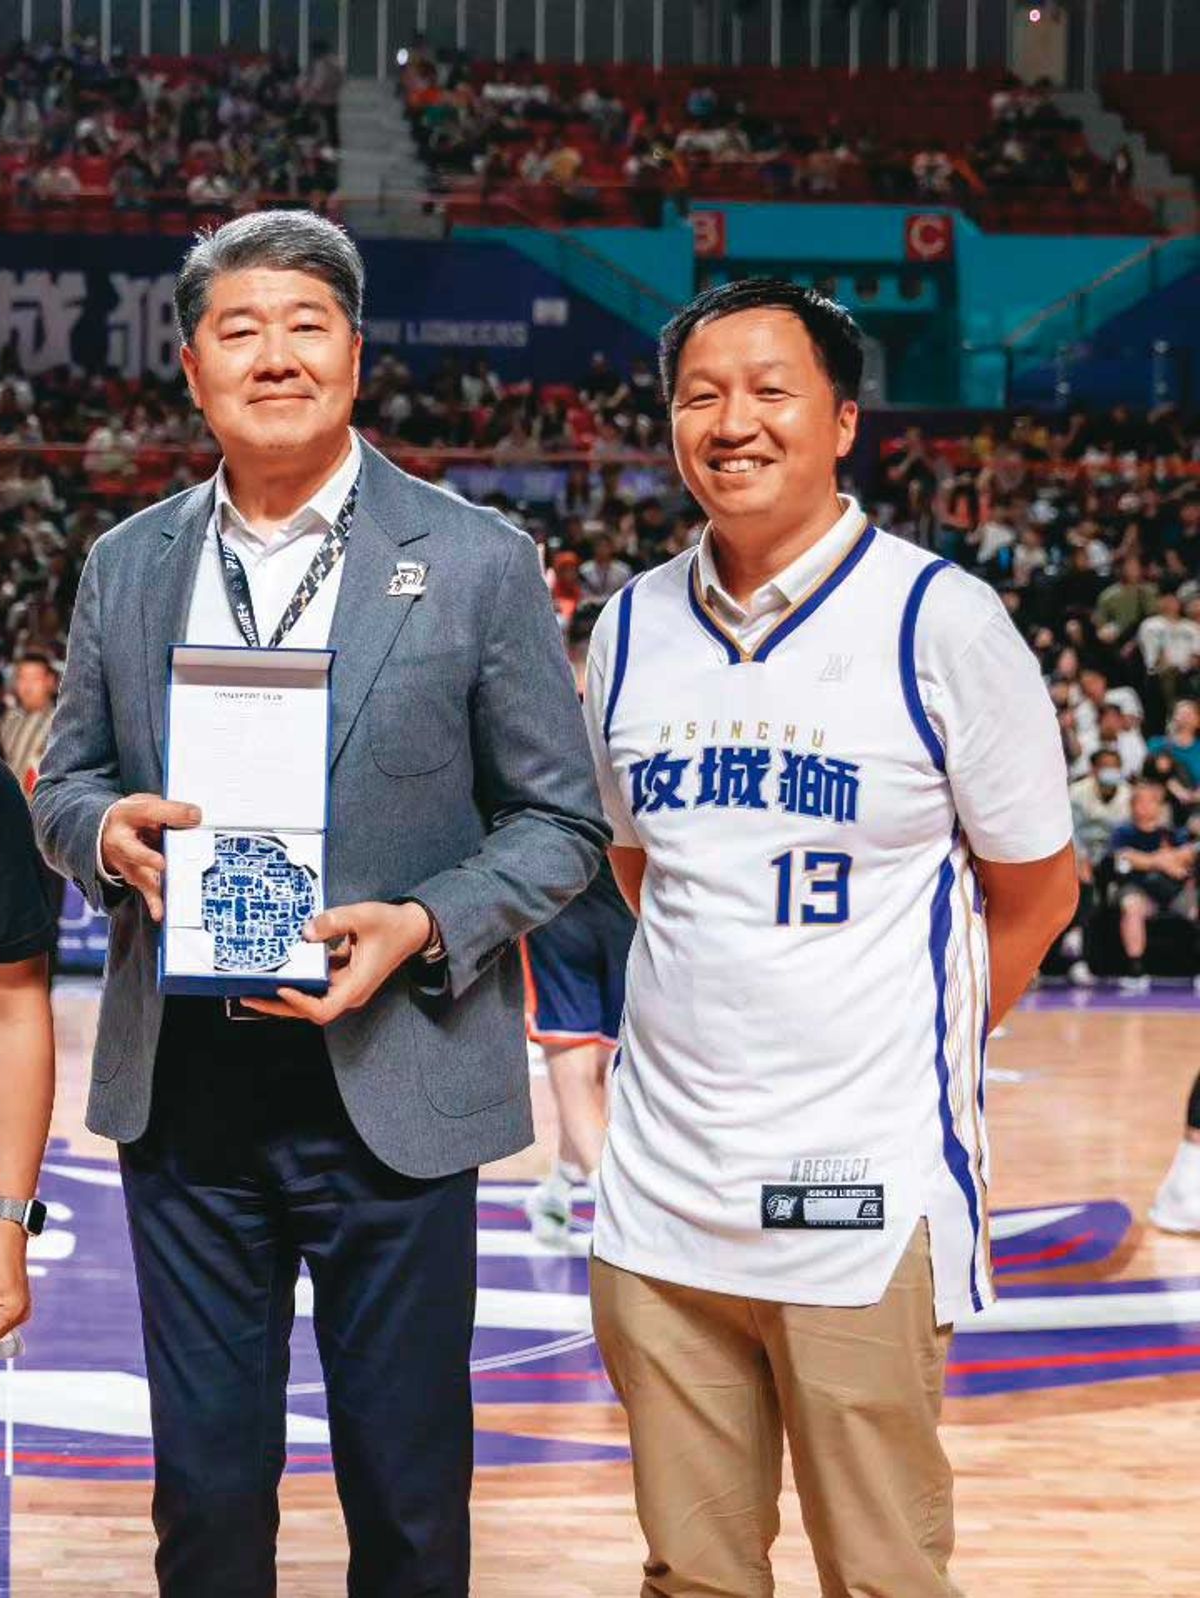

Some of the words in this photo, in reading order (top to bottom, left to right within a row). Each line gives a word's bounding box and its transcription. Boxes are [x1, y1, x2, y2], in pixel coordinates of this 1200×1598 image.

[910, 216, 946, 255] C
[659, 719, 826, 748] HSINCHU
[628, 746, 861, 825] 攻城獅
[769, 848, 854, 927] 13
